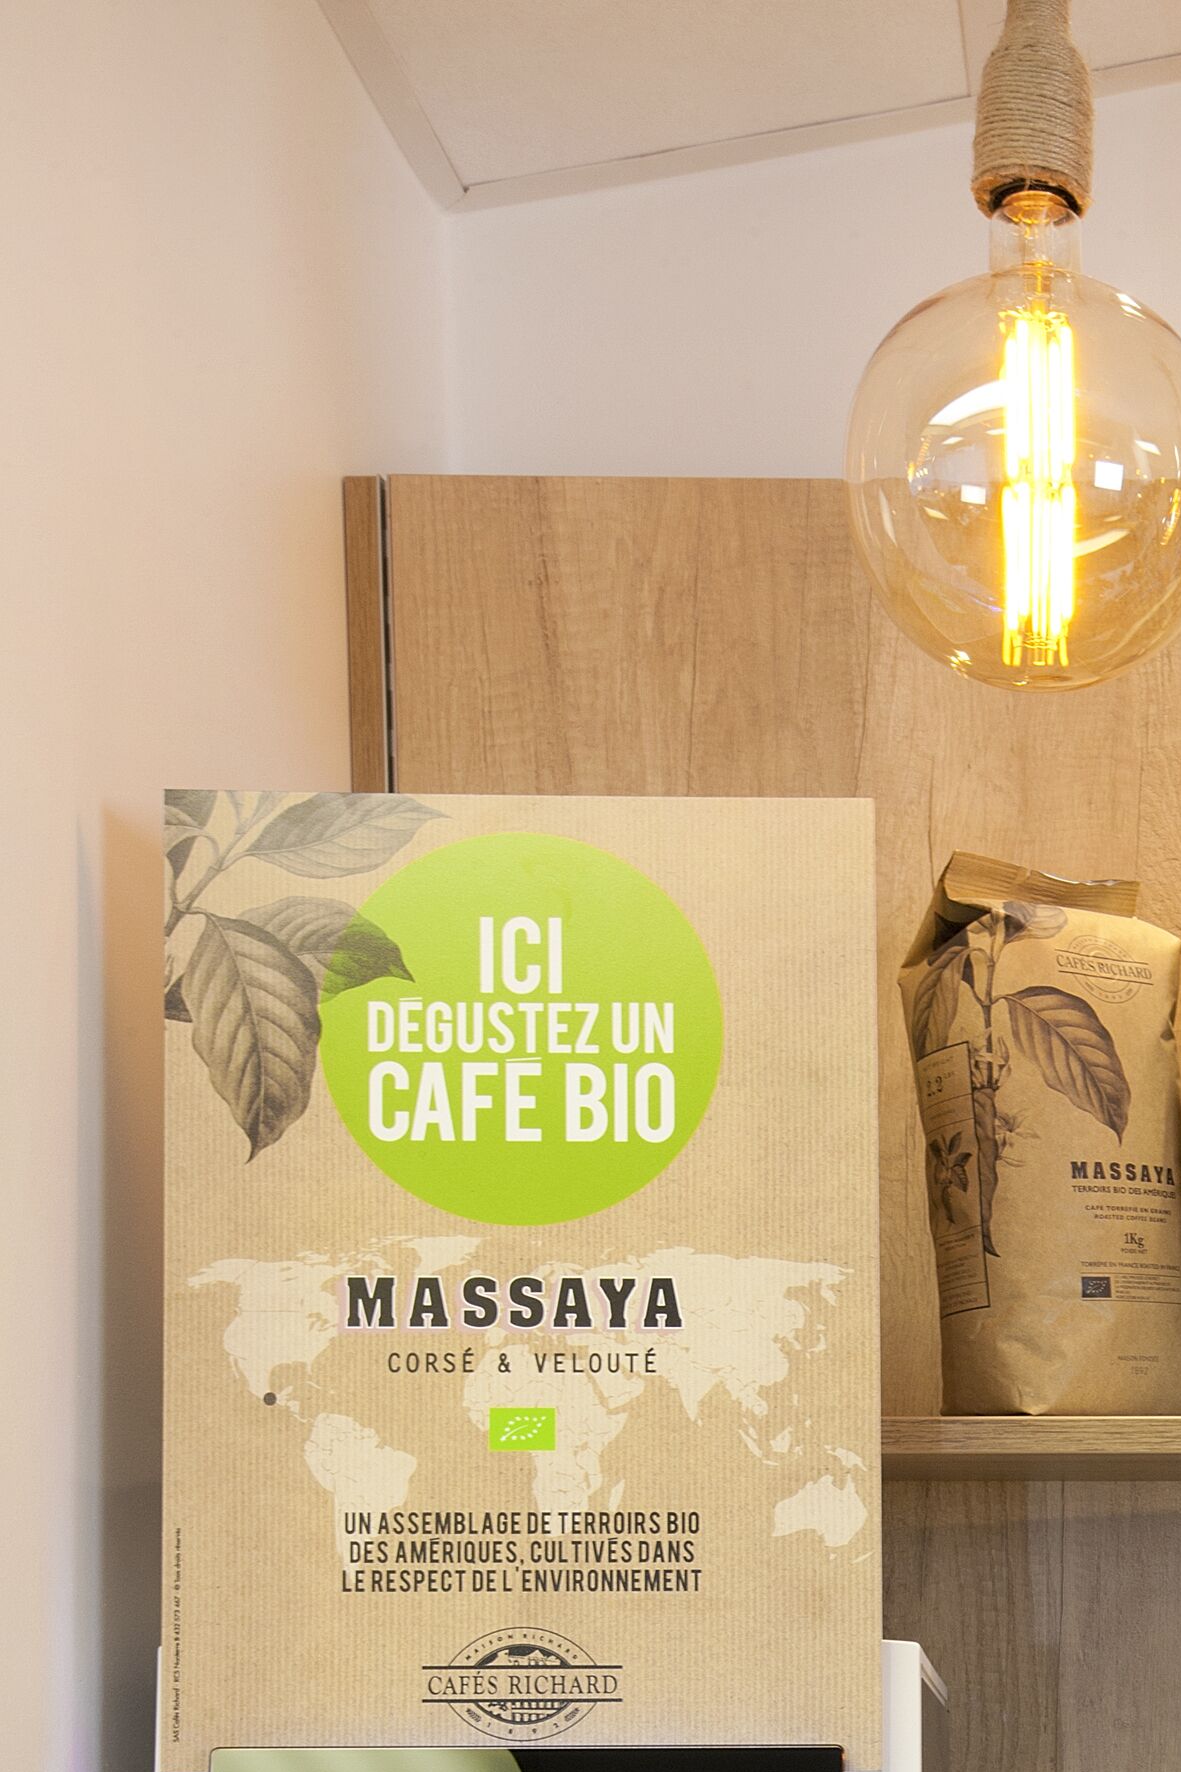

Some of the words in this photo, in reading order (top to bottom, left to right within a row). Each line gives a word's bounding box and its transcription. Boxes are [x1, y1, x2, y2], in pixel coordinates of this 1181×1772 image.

[479, 916, 562, 994] ICI
[1097, 962, 1152, 980] RICHARD
[368, 997, 599, 1054] DÉGUSTEZ
[612, 1003, 674, 1054] UN
[368, 1057, 541, 1142] CAFÉ
[565, 1062, 675, 1143] BIO
[1071, 1161, 1175, 1186] MASSAYA
[1072, 1185, 1111, 1194] TERROIRS
[1113, 1186, 1127, 1195] BIO
[1128, 1187, 1142, 1196] DES
[1124, 1232, 1144, 1249] 1Kg
[346, 1276, 684, 1329] MASSAYA
[388, 1348, 475, 1374] CORSÉ
[498, 1353, 512, 1374] &
[534, 1348, 658, 1374] VELOUTÉ
[345, 1512, 371, 1535] UN
[378, 1511, 521, 1535] ASSEMBLAGE
[527, 1511, 552, 1535] DE
[558, 1511, 660, 1535] TERROIRS
[667, 1511, 700, 1535] BIO
[349, 1541, 389, 1563] DES
[396, 1538, 524, 1567] AMÉRIQUES,
[530, 1538, 633, 1563] CULTIVÉS
[639, 1540, 695, 1563] DANS
[342, 1570, 365, 1592] LE
[371, 1570, 466, 1592] RESPECT
[473, 1570, 496, 1592] DE
[503, 1566, 702, 1592] L'ENVIRONNEMENT
[465, 1634, 513, 1661] MAISON
[523, 1633, 578, 1660] RICHARD
[427, 1671, 498, 1695] CAFÉS
[508, 1673, 618, 1695] RICHARD
